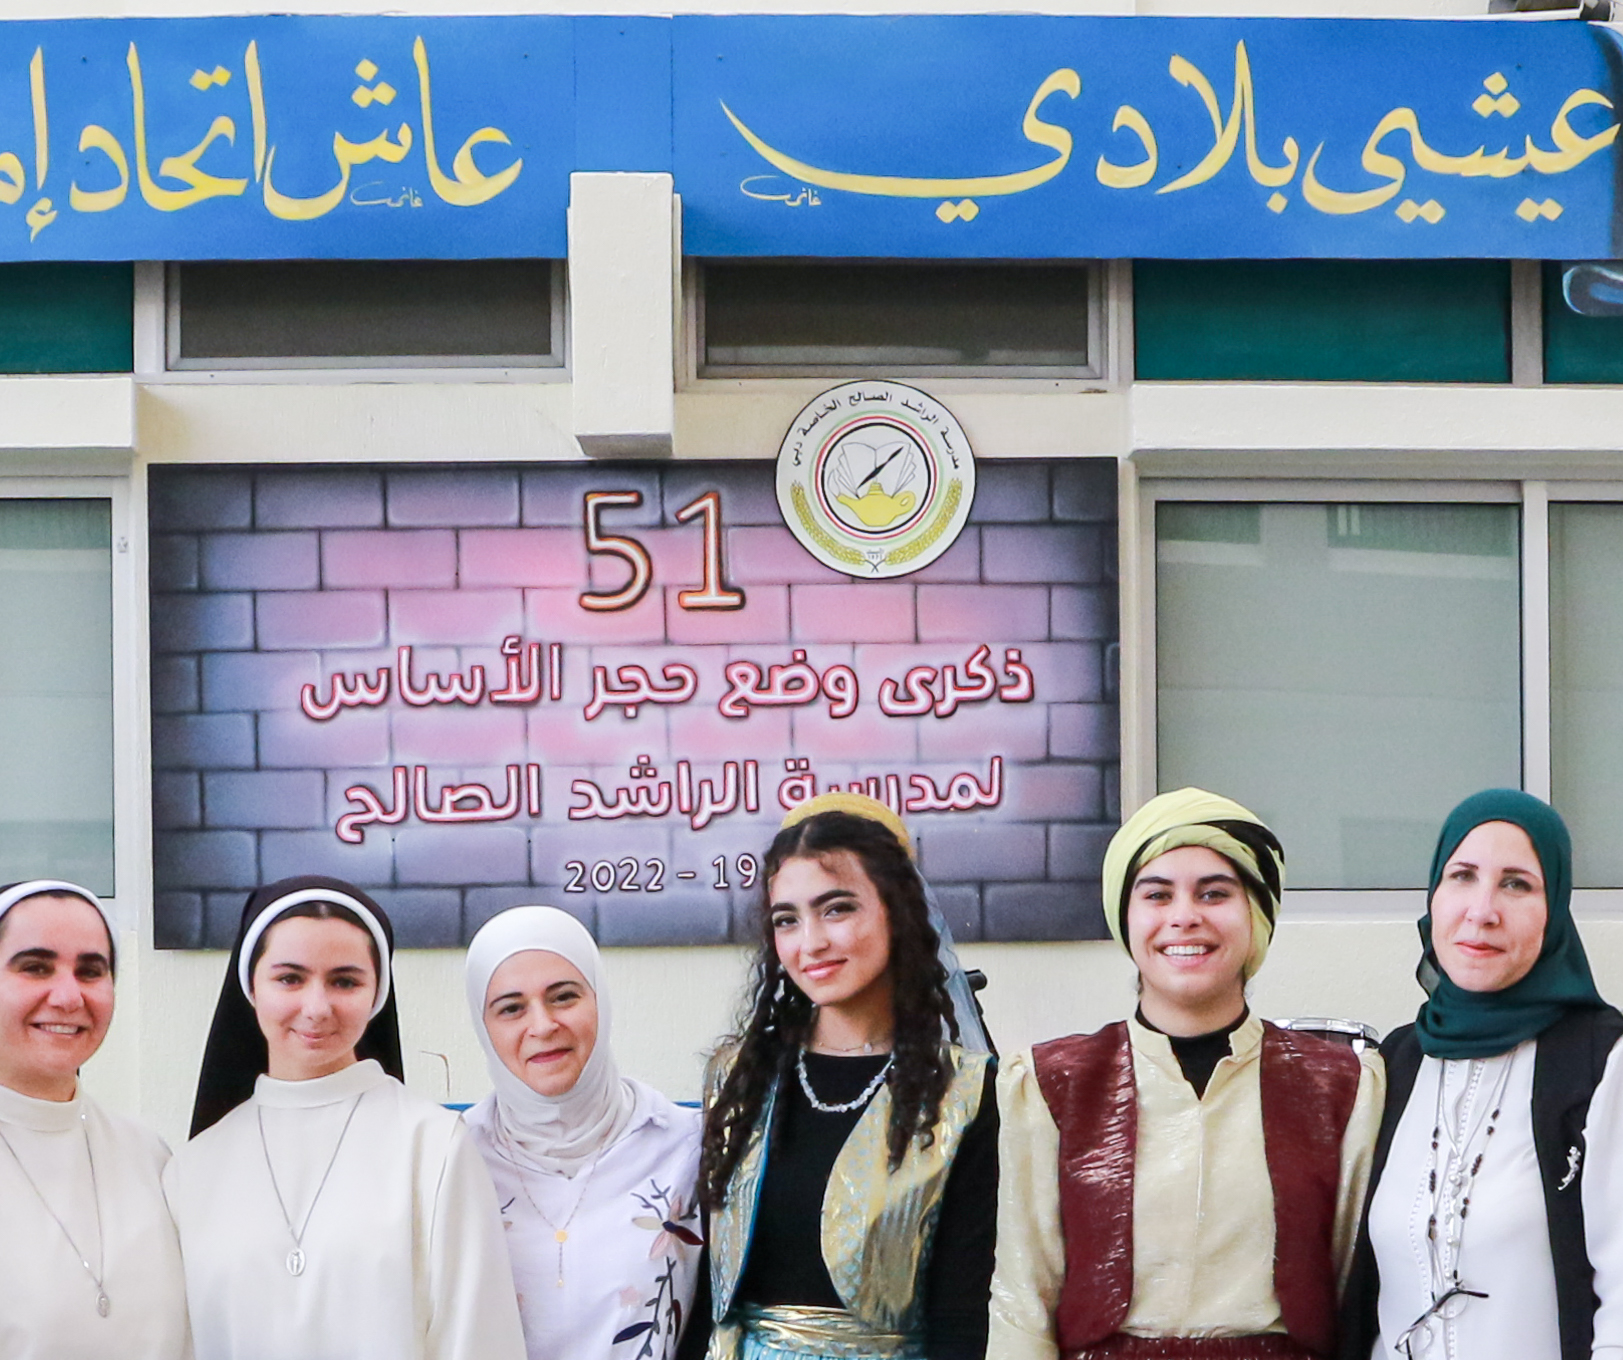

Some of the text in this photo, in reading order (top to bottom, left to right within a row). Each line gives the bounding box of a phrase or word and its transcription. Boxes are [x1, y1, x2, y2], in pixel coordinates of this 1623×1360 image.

[69, 41, 267, 212] اتحاد
[264, 37, 523, 221] عاش
[720, 40, 1299, 223] بلادي
[1303, 72, 1621, 224] عيشي
[848, 391, 893, 407] الصالح
[900, 398, 939, 425] الراشد
[939, 426, 961, 470] مدرسة
[578, 490, 747, 612] 51
[300, 635, 1035, 722] ذكرى وضع حجر الأساس
[335, 762, 541, 844] الصالح
[568, 754, 760, 832] الراشد
[563, 856, 666, 893] 2022
[711, 852, 759, 889] 19
